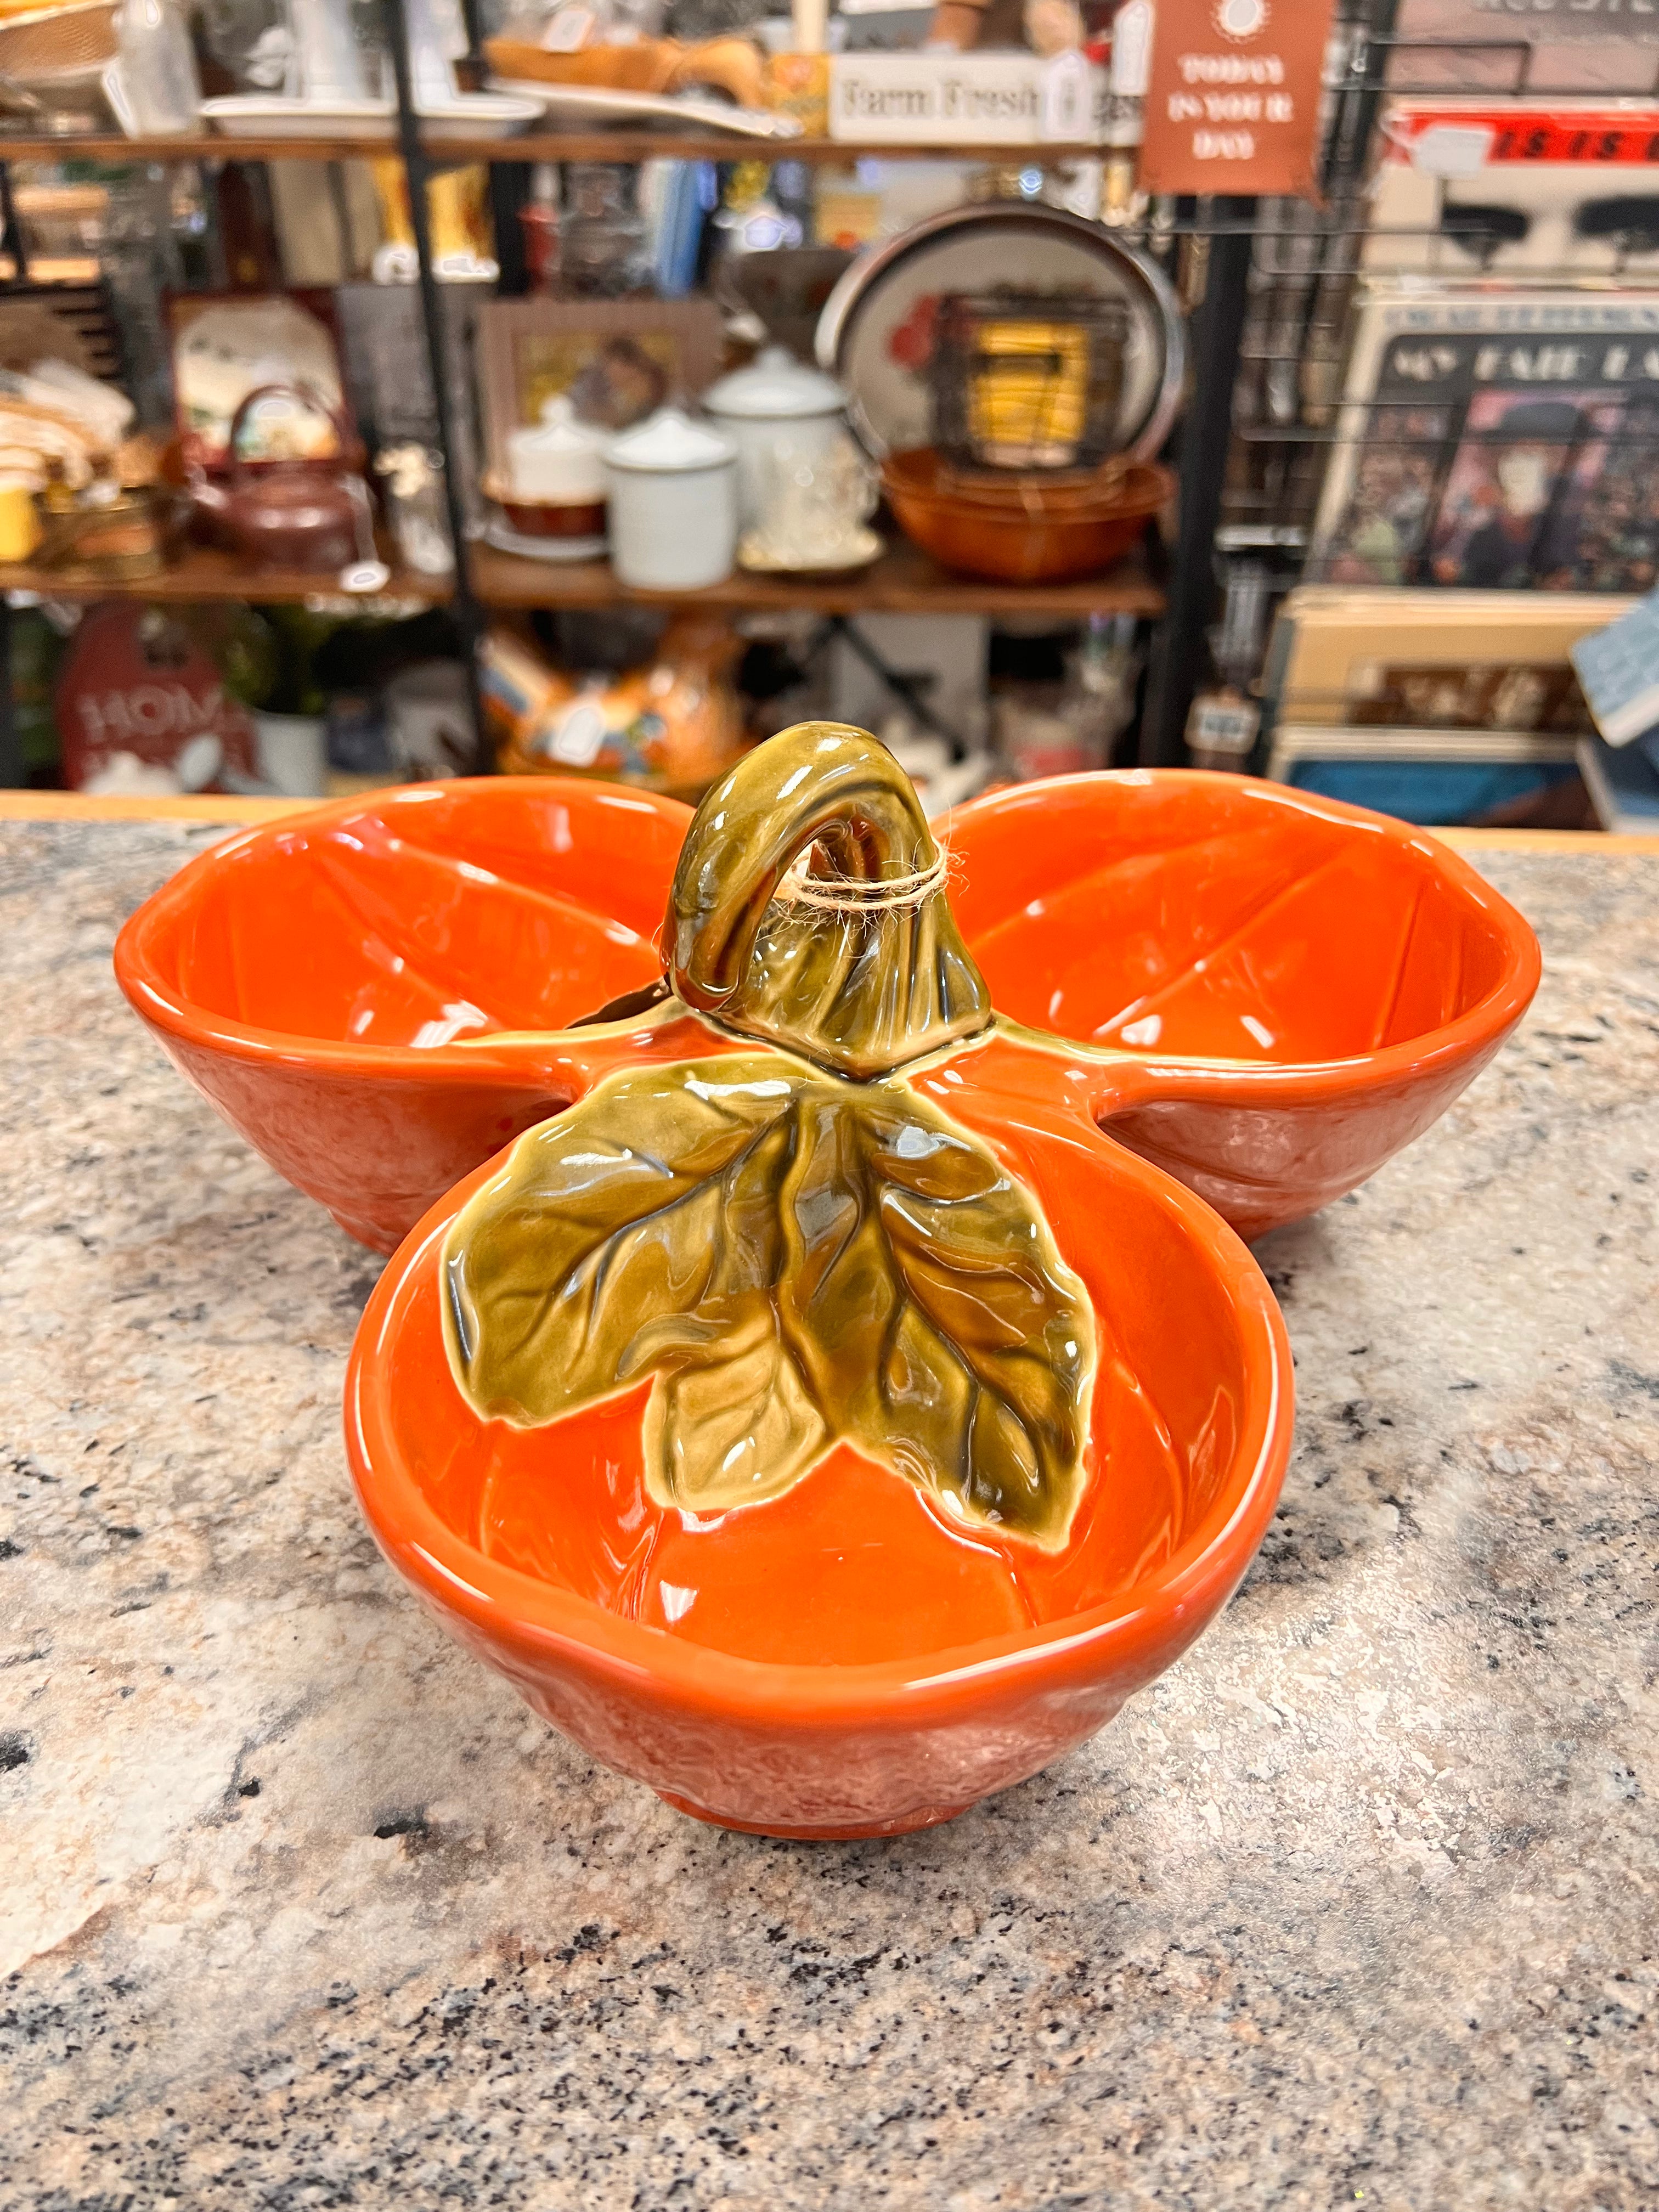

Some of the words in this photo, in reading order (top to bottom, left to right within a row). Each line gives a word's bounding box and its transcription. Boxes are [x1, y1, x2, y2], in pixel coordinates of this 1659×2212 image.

[842, 78, 929, 117] Farm
[940, 77, 1039, 120] Fresh
[77, 682, 237, 746] HOM
